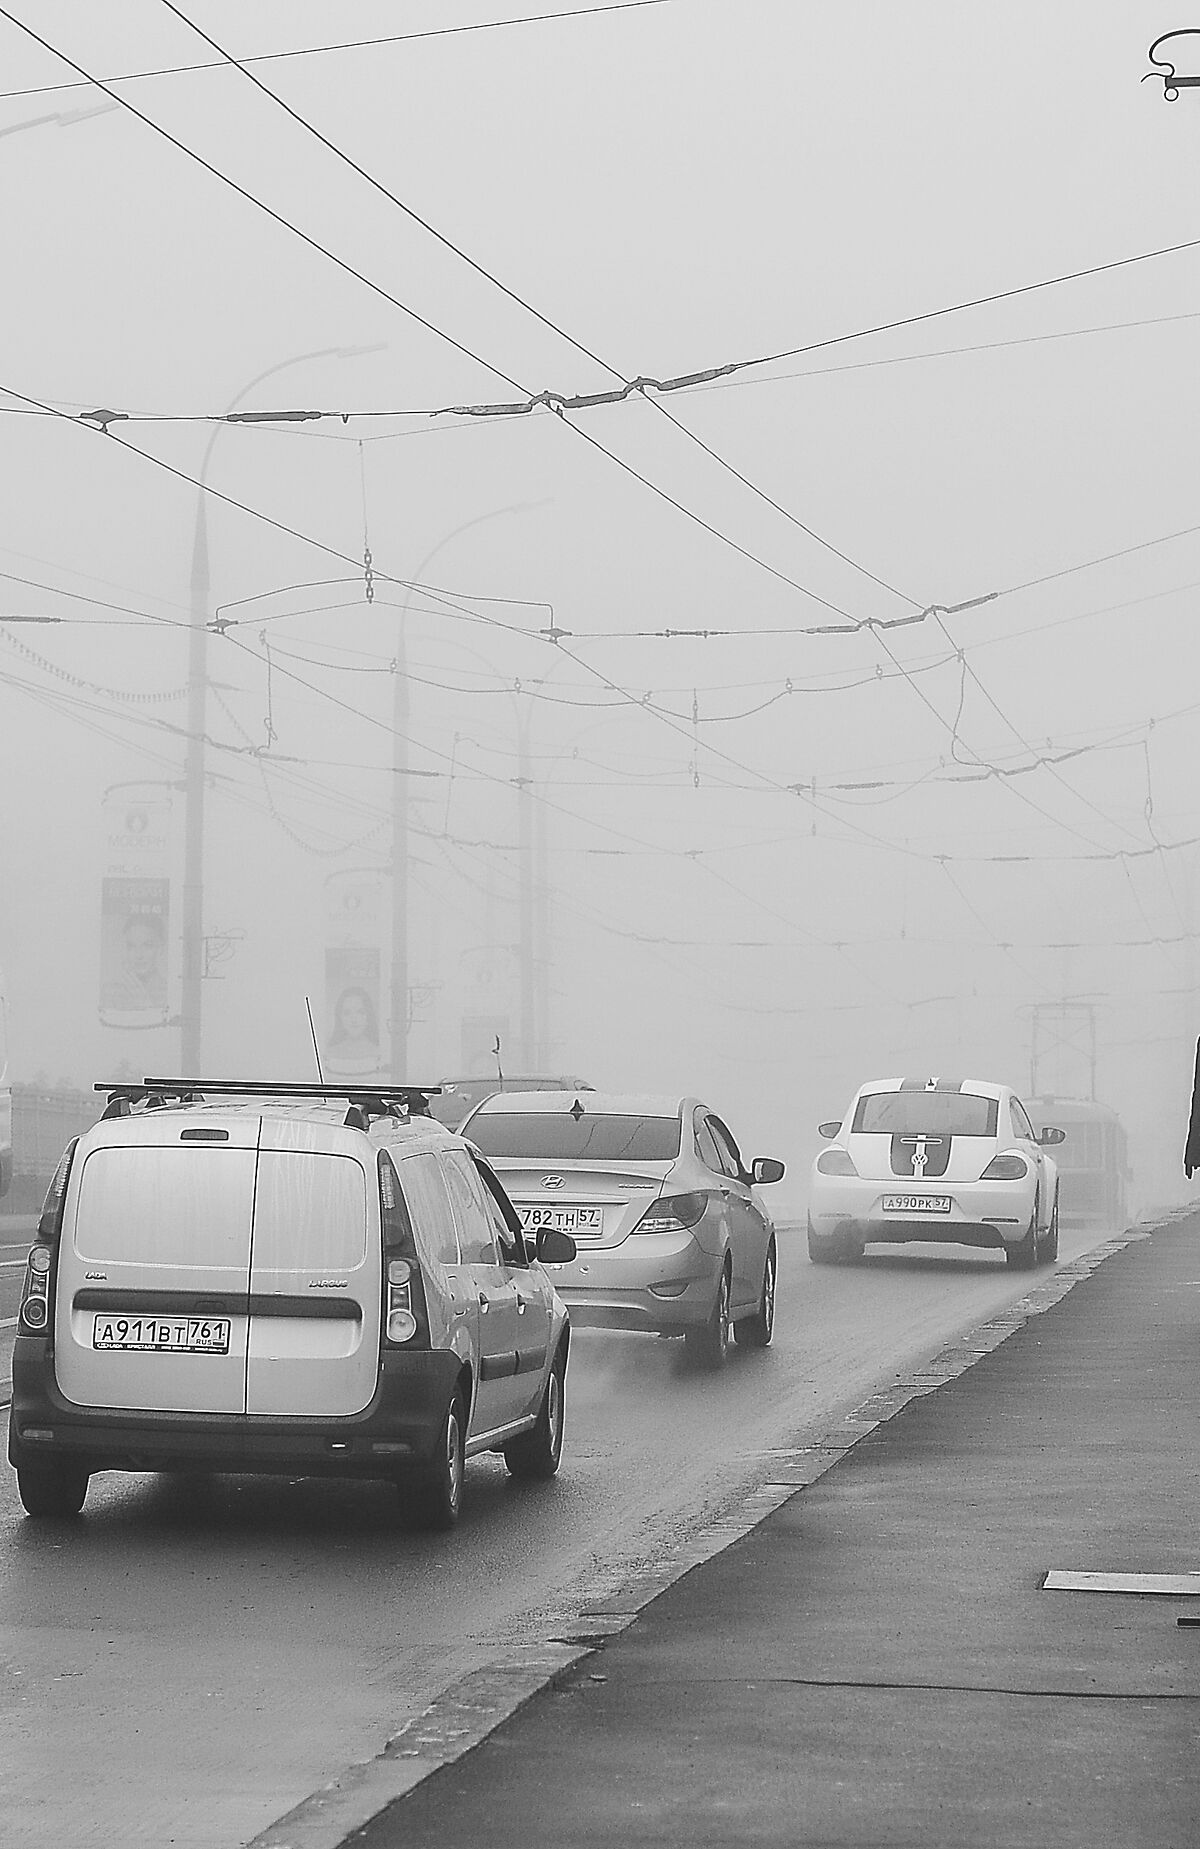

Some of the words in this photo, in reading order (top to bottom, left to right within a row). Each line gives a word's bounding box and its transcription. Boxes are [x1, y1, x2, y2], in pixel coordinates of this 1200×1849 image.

[935, 1197, 946, 1206] 57
[521, 1209, 575, 1226] 782ТН
[579, 1210, 595, 1222] 57
[102, 1319, 185, 1343] А911ВТ
[190, 1321, 224, 1340] 761
[196, 1338, 212, 1346] RUS
